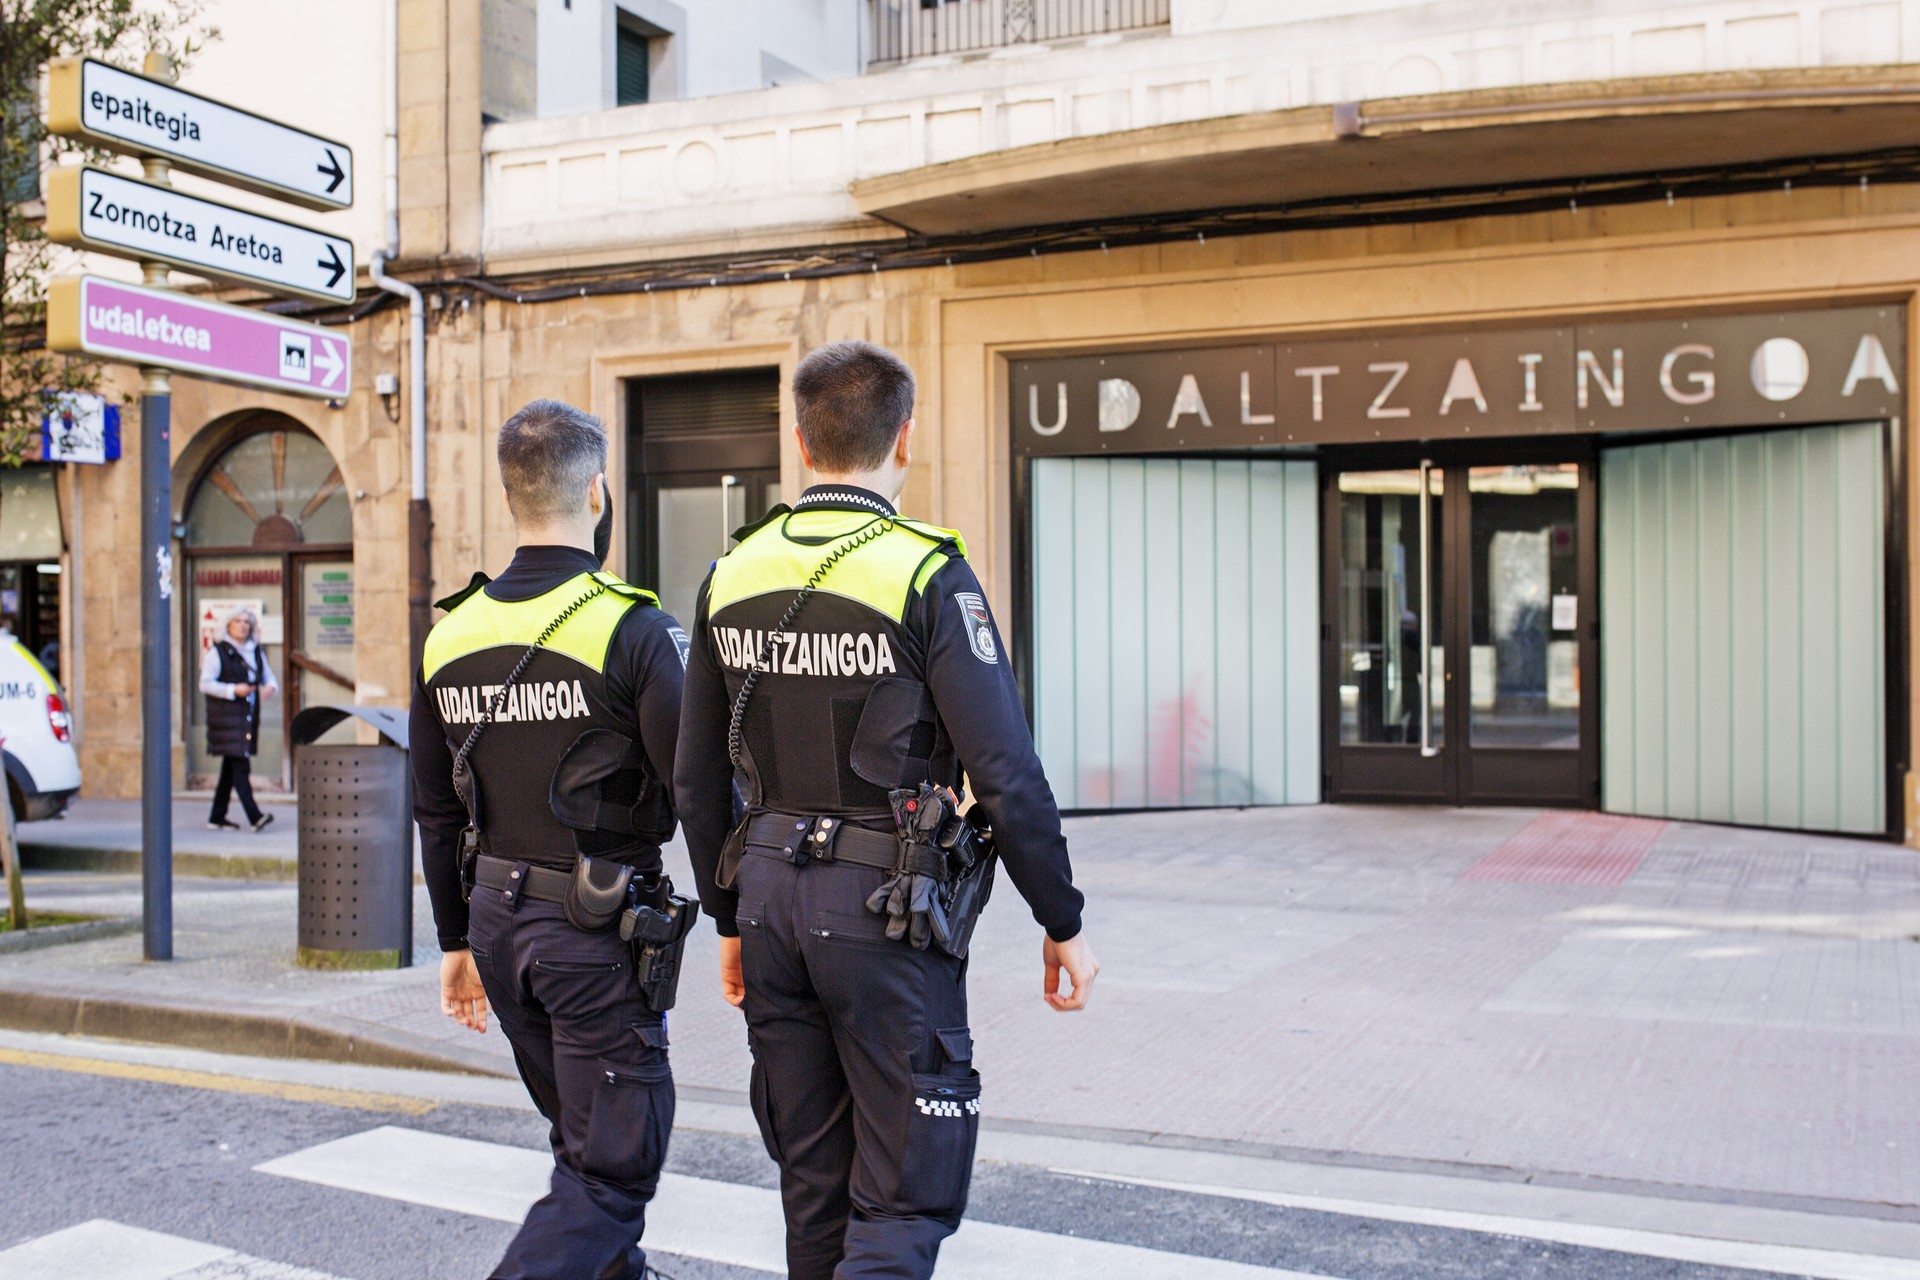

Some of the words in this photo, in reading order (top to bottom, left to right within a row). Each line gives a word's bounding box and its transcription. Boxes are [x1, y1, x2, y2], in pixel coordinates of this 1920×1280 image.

[90, 89, 201, 142] epaitegia
[89, 191, 197, 243] Zornotza
[210, 225, 283, 265] Aretoa
[88, 304, 212, 352] udaletxea
[1028, 333, 1900, 437] UDALTZAINGOA
[713, 626, 897, 677] UDALTZAINGOA
[436, 679, 591, 724] UDALTZAINGOA
